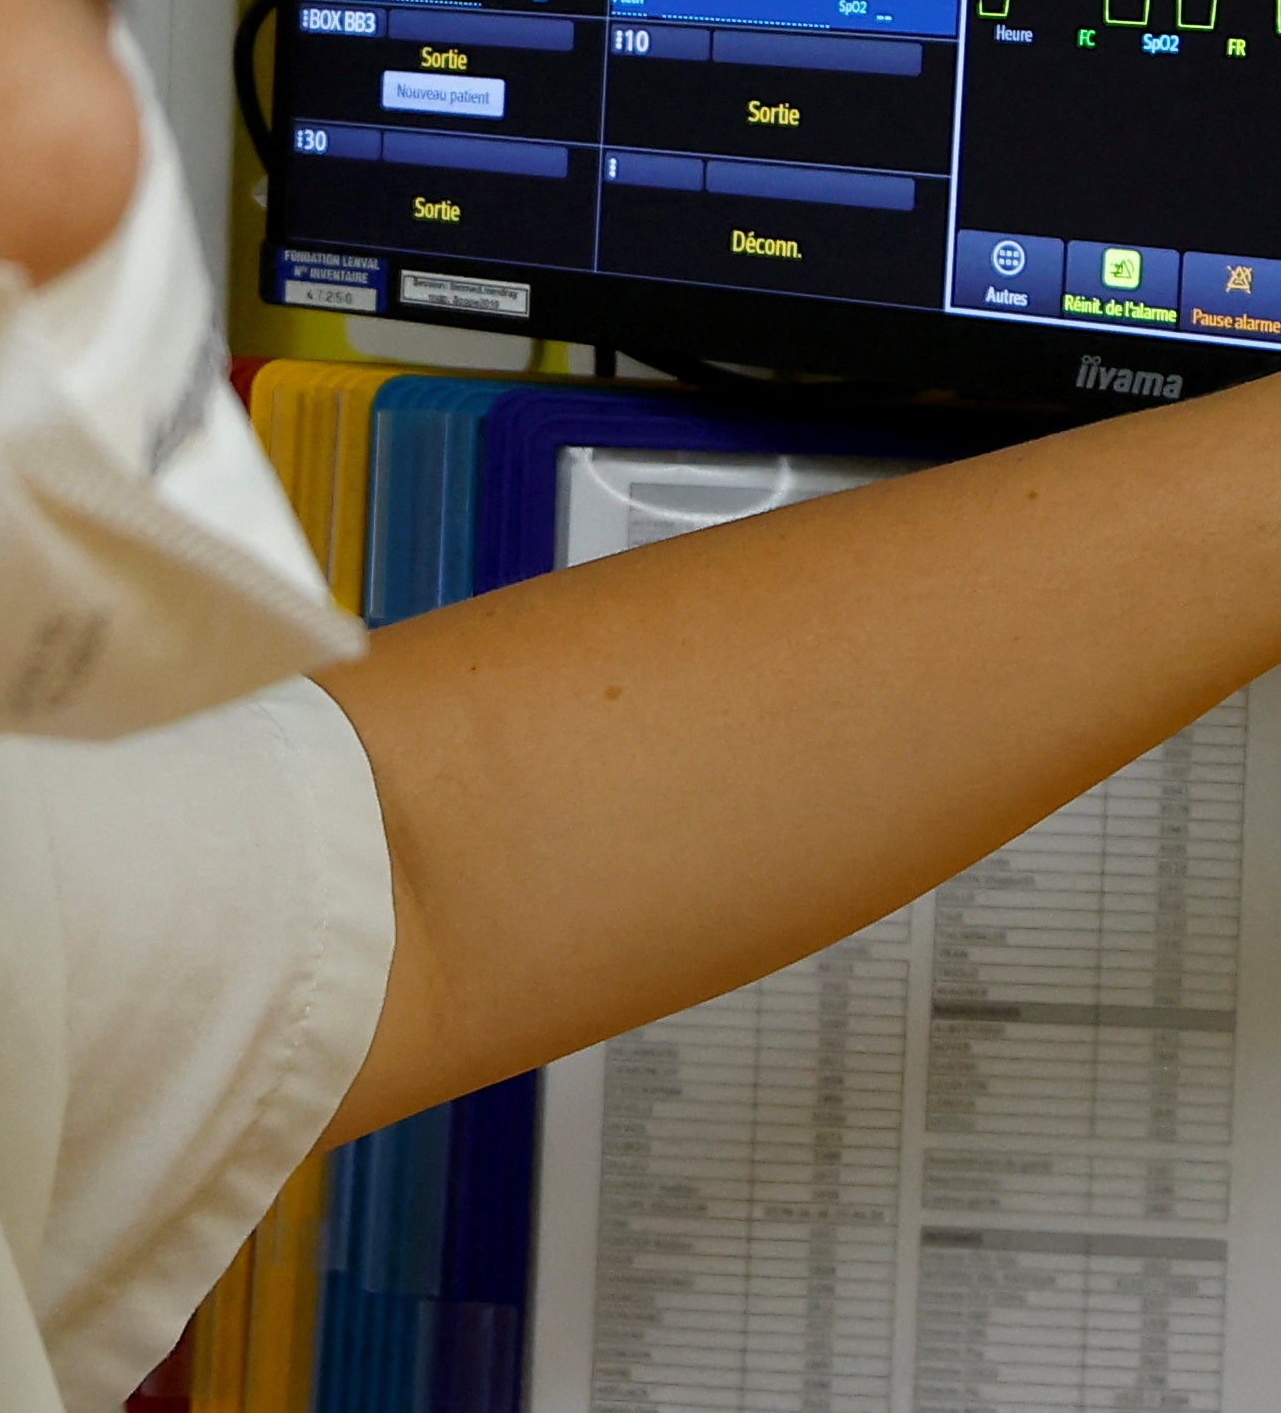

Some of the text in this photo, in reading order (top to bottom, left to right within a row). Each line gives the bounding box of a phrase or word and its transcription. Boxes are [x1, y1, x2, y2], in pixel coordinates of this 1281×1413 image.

[838, 0, 868, 16] SpO2
[309, 8, 376, 34] BOX BB3
[625, 30, 650, 53] 10
[995, 24, 1034, 43] Heure
[1077, 29, 1096, 47] FC
[1143, 34, 1180, 54] SpO2
[1226, 38, 1247, 57] FR
[421, 46, 468, 70] Sortie
[396, 84, 490, 106] Nouveau patient
[747, 100, 801, 126] Sortie
[304, 130, 328, 152] 30
[414, 198, 461, 222] Sortie
[731, 229, 803, 259] Déconn.
[284, 249, 380, 271] FONDATION LENVAL
[309, 266, 370, 284] INVENTAIRE
[985, 286, 1029, 306] Autres
[1063, 293, 1178, 324] Réinit. de l'alarme
[1192, 307, 1281, 335] Pause alarme
[1075, 354, 1185, 400] iiyama
